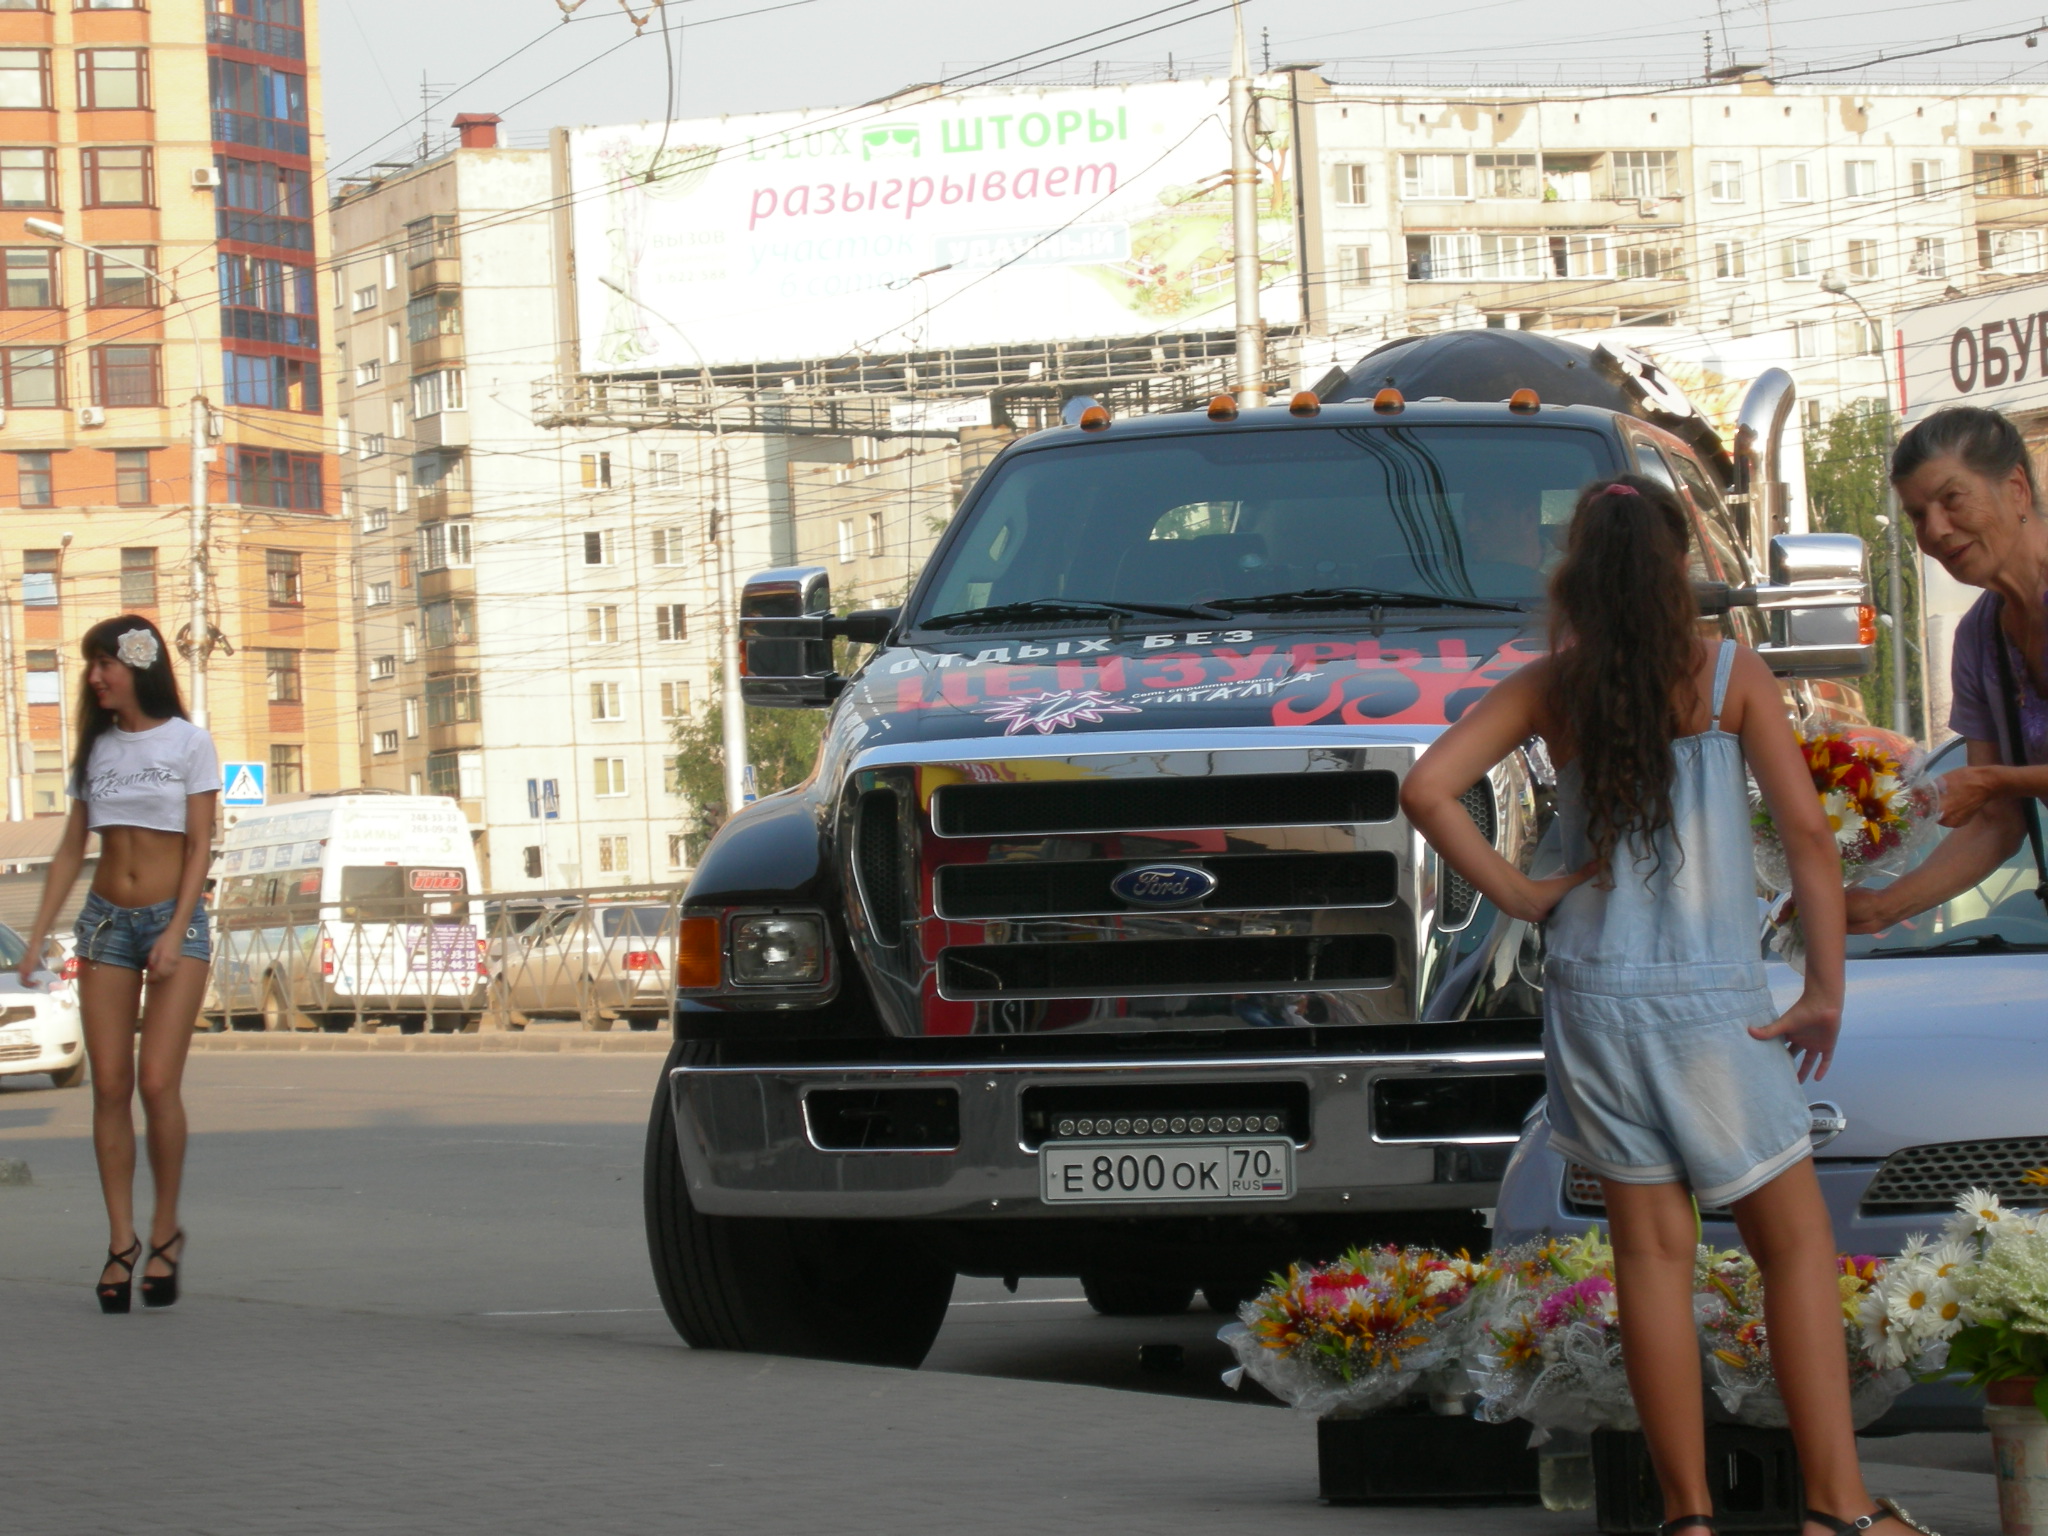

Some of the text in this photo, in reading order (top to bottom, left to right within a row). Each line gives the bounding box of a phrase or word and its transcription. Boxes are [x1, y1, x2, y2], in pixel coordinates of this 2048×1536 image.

[940, 105, 1128, 154] ШТОРЫ
[748, 161, 1118, 231] разыгрывает
[652, 229, 726, 249] ВЫЗОВ
[747, 225, 1115, 276] участок УДАЧНЫЙ
[889, 629, 1254, 675] ОТДЫХ БЕЗ
[895, 638, 1469, 714] ЦЕНЗУРЫ
[1131, 689, 1166, 699] Сеть
[1133, 871, 1191, 896] Ford
[1232, 1150, 1272, 1179] 70
[1232, 1180, 1262, 1191] RUS
